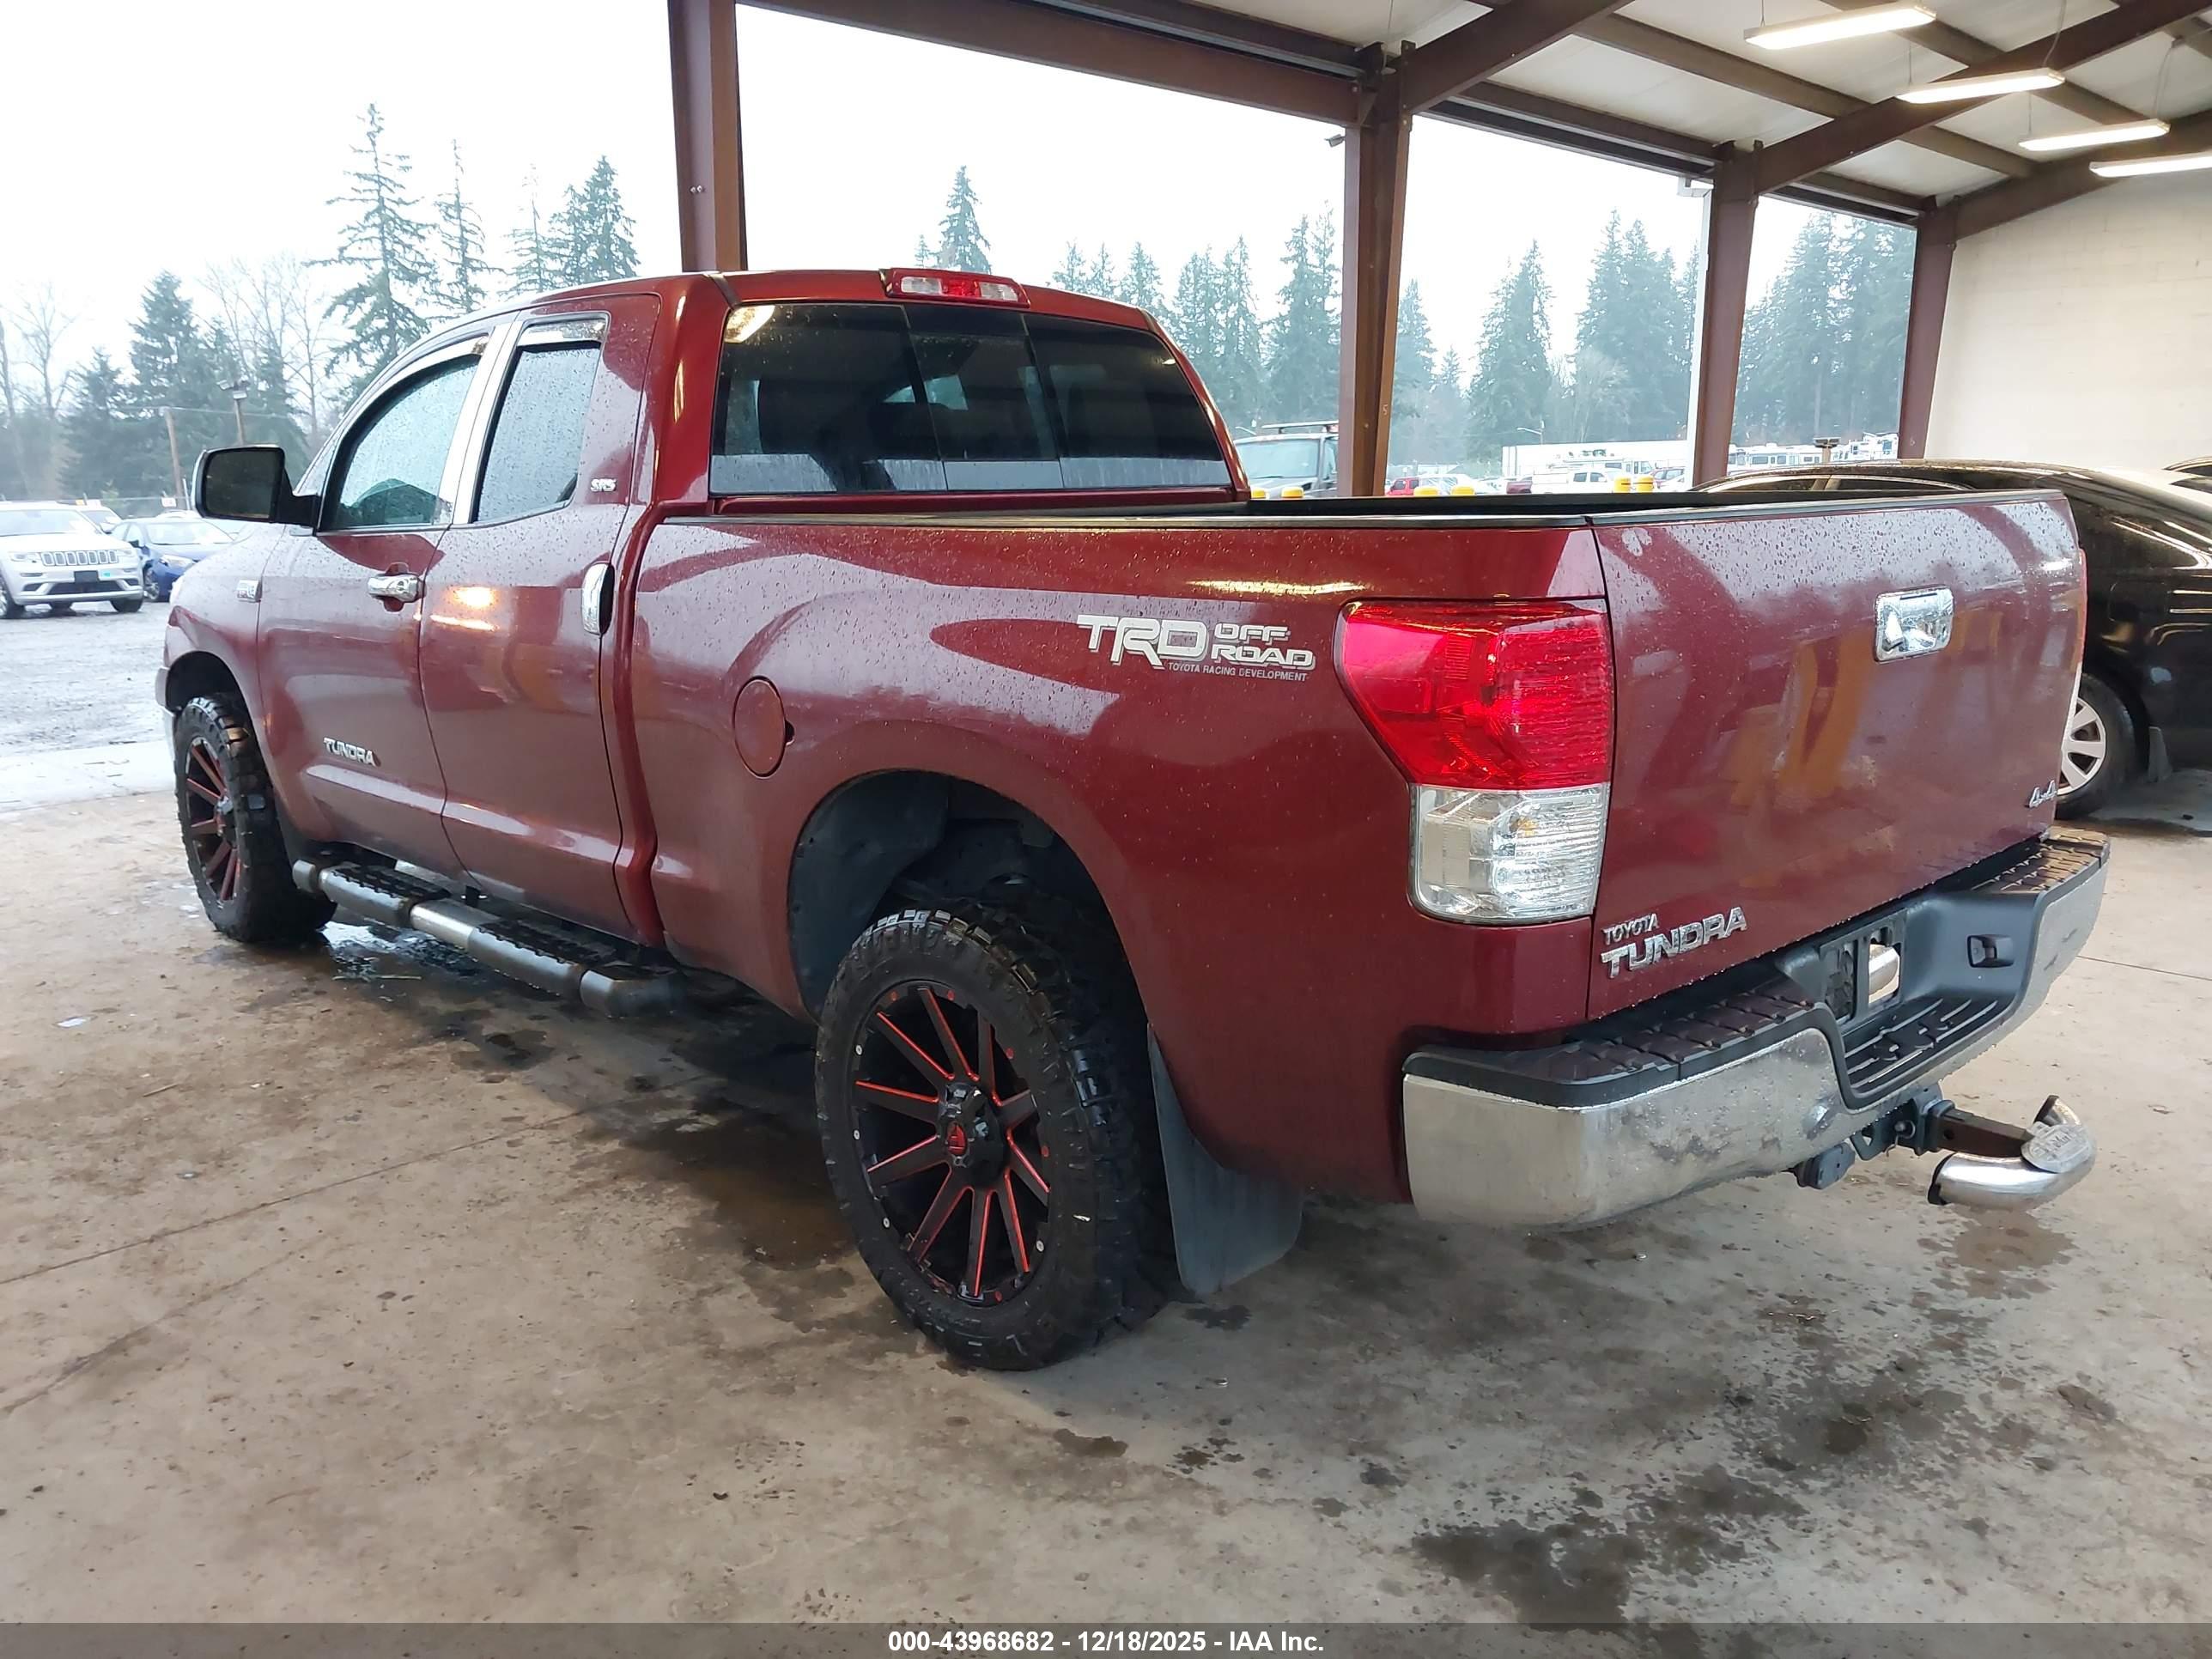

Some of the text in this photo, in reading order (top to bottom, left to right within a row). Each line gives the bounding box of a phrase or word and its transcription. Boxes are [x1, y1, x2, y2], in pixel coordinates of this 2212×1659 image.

[1076, 614, 1207, 670] TRD
[1214, 623, 1291, 643] OFF
[1168, 661, 1308, 682] TOYOTA RACING DEVELOPMENT
[1211, 643, 1316, 670] ROAD
[323, 737, 376, 767] TUNDRA
[1601, 913, 1660, 945] TOYOTA
[1601, 906, 1747, 978] TUNDRA
